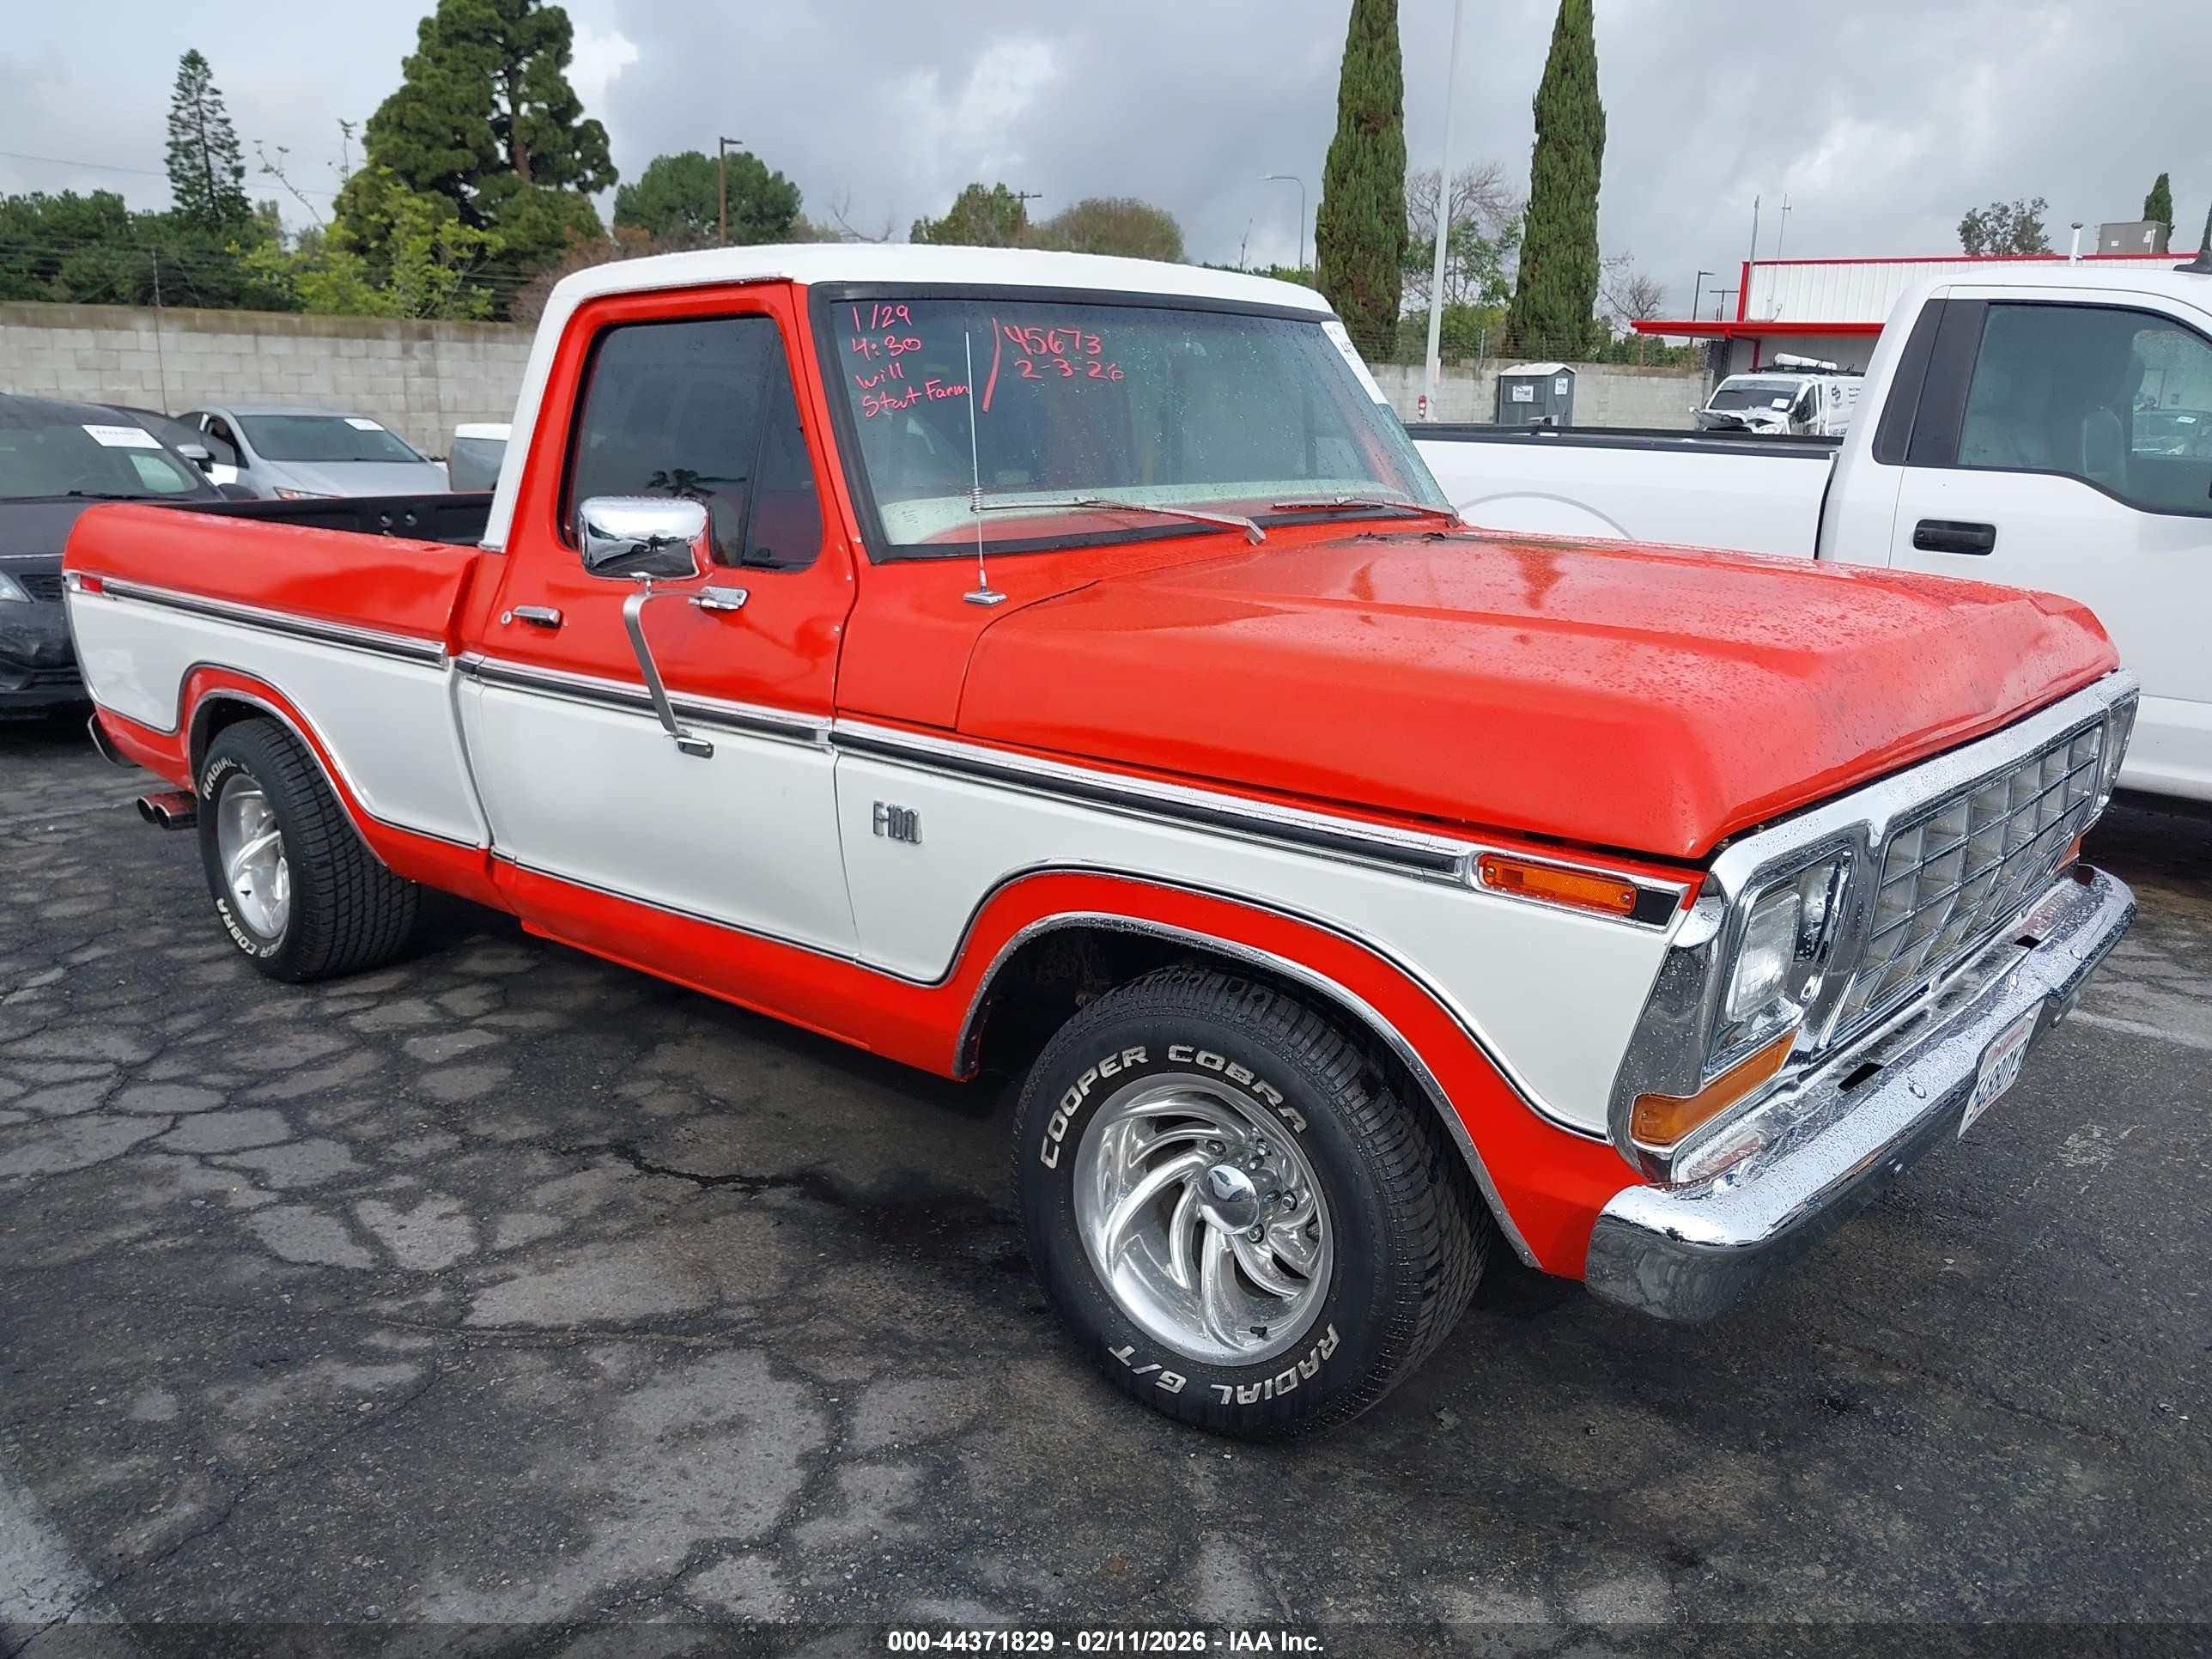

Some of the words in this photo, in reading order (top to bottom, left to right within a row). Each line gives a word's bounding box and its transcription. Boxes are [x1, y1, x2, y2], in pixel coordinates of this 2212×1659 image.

[852, 304, 913, 332] 1/29
[851, 335, 921, 361] 4:30
[924, 380, 969, 401] Farm
[1014, 358, 1124, 382] 2-3-26
[202, 757, 238, 800] RADIAL
[216, 898, 258, 955] COBRA
[1040, 1045, 1150, 1169] COOPER
[1168, 1044, 1307, 1133] COBRA
[1108, 1345, 1187, 1394] G/T
[1210, 1322, 1340, 1405] RADIAL
